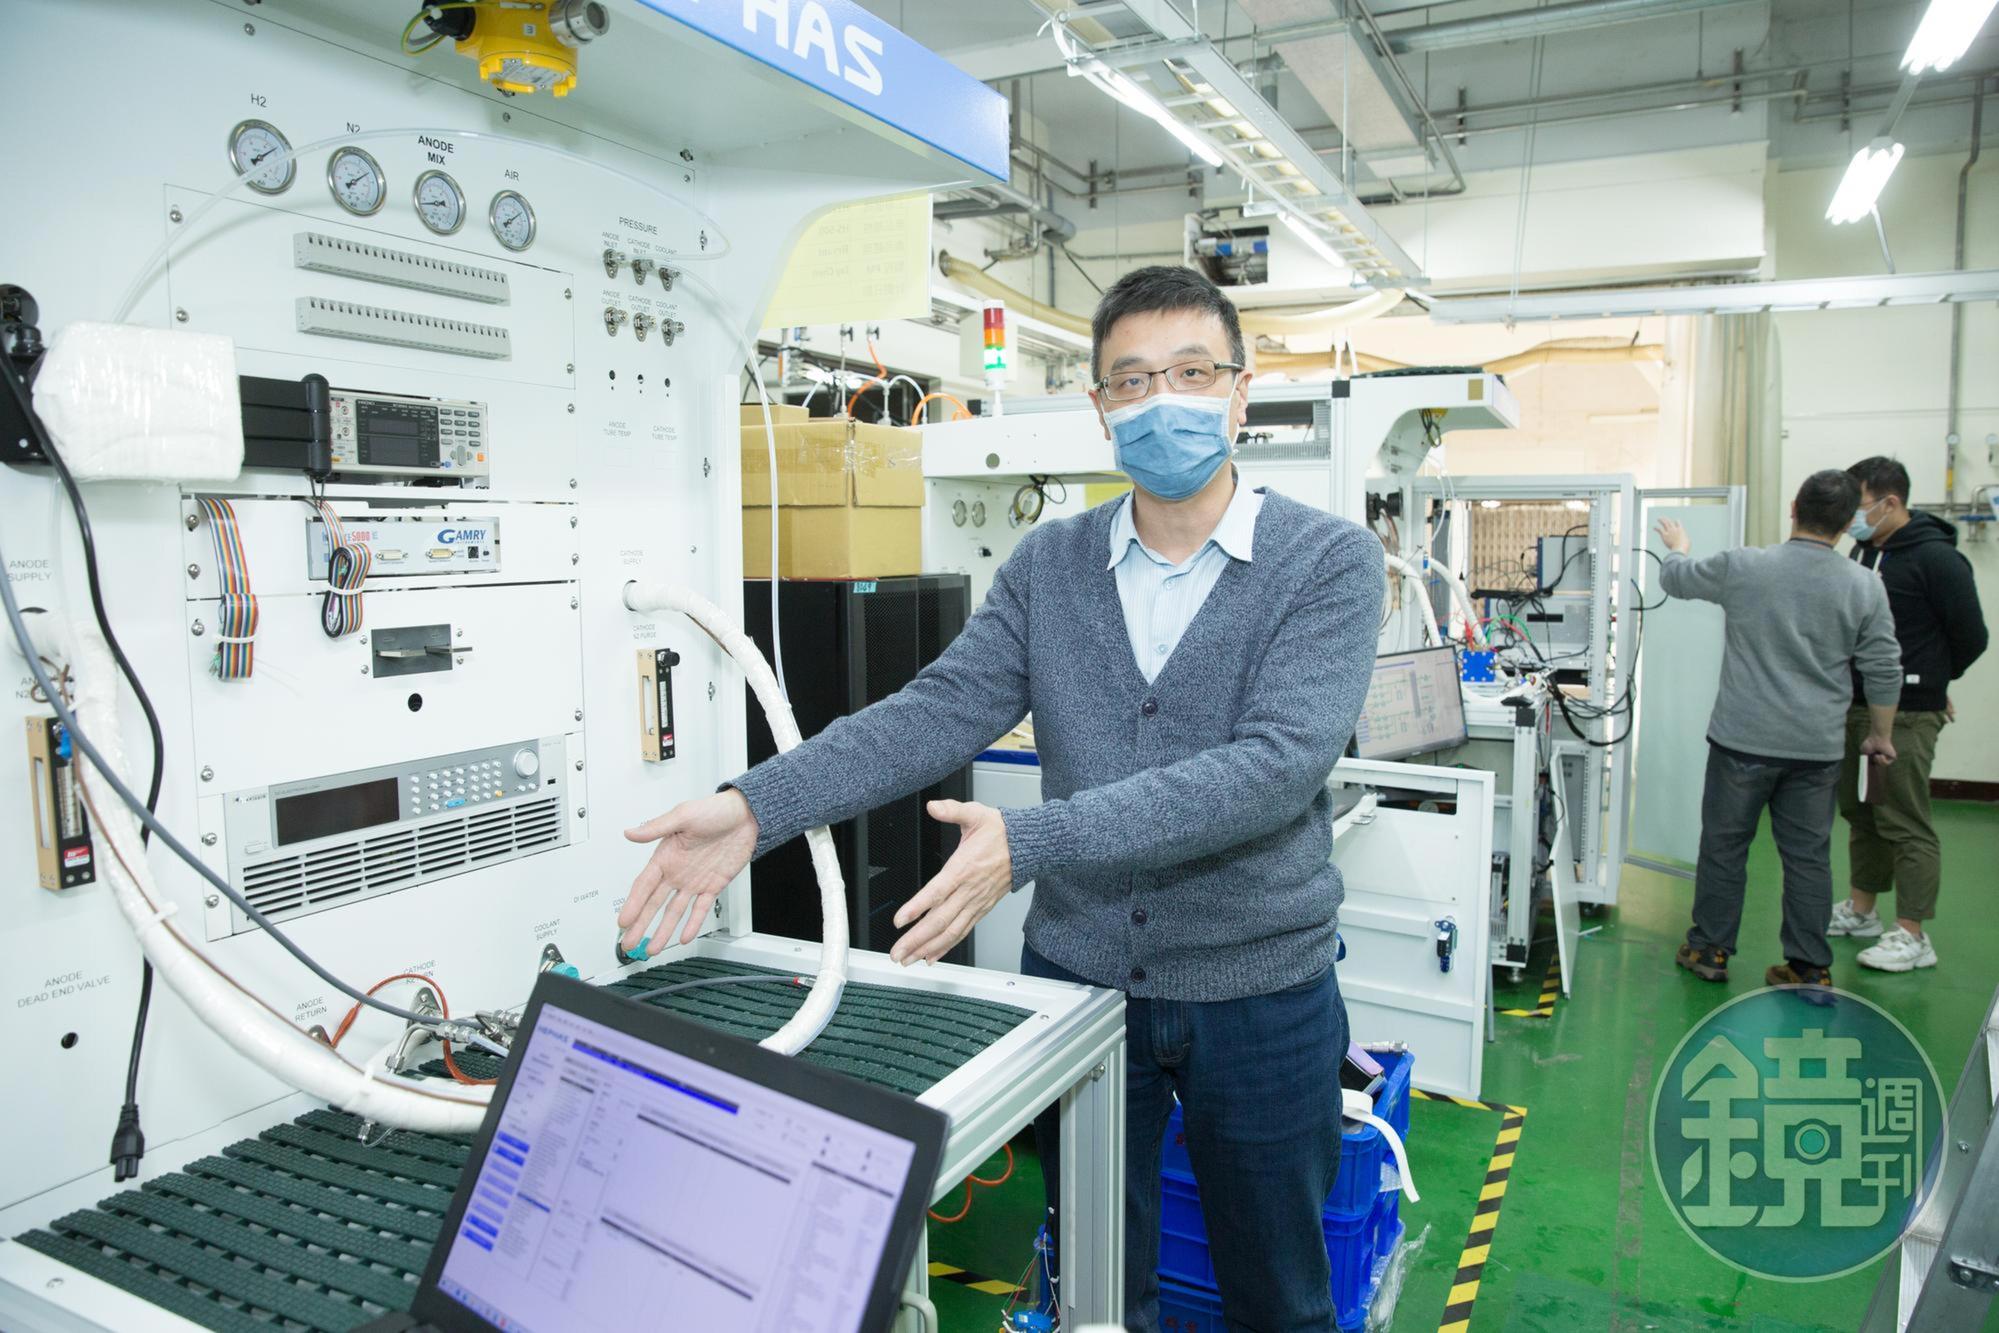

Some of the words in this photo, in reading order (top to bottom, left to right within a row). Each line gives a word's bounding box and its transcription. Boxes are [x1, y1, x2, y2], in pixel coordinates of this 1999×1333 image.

[690, 0, 883, 96] HAS
[250, 93, 267, 108] H2
[346, 122, 361, 134] N2
[417, 135, 454, 154] ANODE
[427, 151, 446, 166] MIX
[504, 169, 520, 182] AIR
[618, 216, 658, 236] PRESSURE
[601, 231, 620, 241] ANODE
[603, 240, 618, 248] INLET
[627, 238, 651, 250] CATHODE
[655, 245, 678, 254] COOLANT
[602, 289, 621, 299] ANODE
[601, 297, 621, 306] OUTLET
[628, 295, 652, 306] CATHODE
[655, 300, 678, 310] COOLANT
[631, 303, 650, 312] OUTLET
[658, 309, 677, 318] OUTLET
[608, 420, 627, 429] ANODE
[653, 425, 675, 434] CATHODE
[437, 529, 486, 544] GAMRY
[9, 559, 49, 569] ANODE
[8, 572, 52, 582] SUPPLY
[632, 623, 656, 632] CATHODE
[640, 631, 657, 639] PURGE
[580, 889, 600, 901] WATER
[534, 918, 561, 933] COOLANT
[536, 929, 558, 942] SUPPLY
[403, 960, 436, 974] CATHODE
[44, 970, 83, 988] ANODE
[17, 992, 49, 1008] DEAD
[51, 985, 76, 999] END
[77, 975, 112, 993] VALVE
[296, 996, 324, 1012] ANODE
[295, 1005, 328, 1023] RETURN
